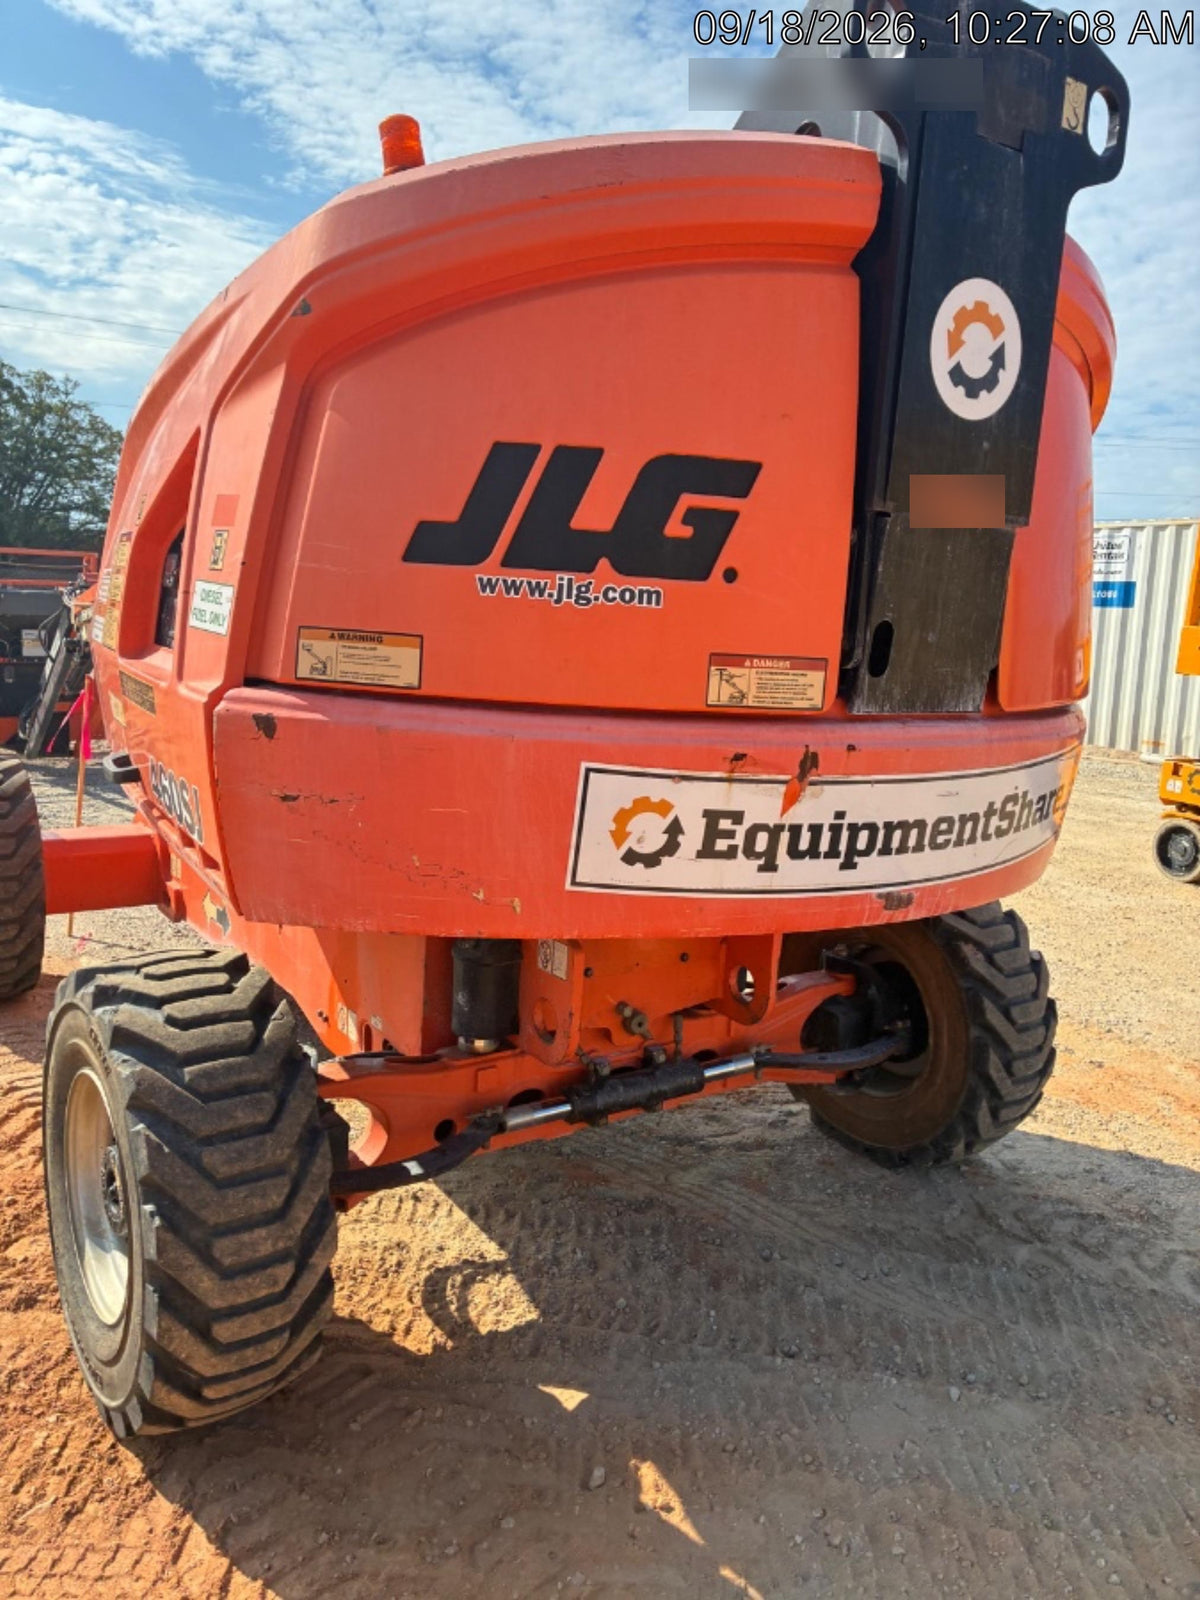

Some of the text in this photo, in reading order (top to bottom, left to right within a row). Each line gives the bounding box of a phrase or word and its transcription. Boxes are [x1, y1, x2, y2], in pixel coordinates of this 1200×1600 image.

[200, 588, 223, 605] DIESEL
[476, 574, 663, 608] www.jlg.com
[192, 607, 227, 627] FUEL ONLY
[337, 632, 384, 644] WARNING
[753, 658, 791, 669] DANGER
[695, 784, 1064, 873] EquipmentShare
